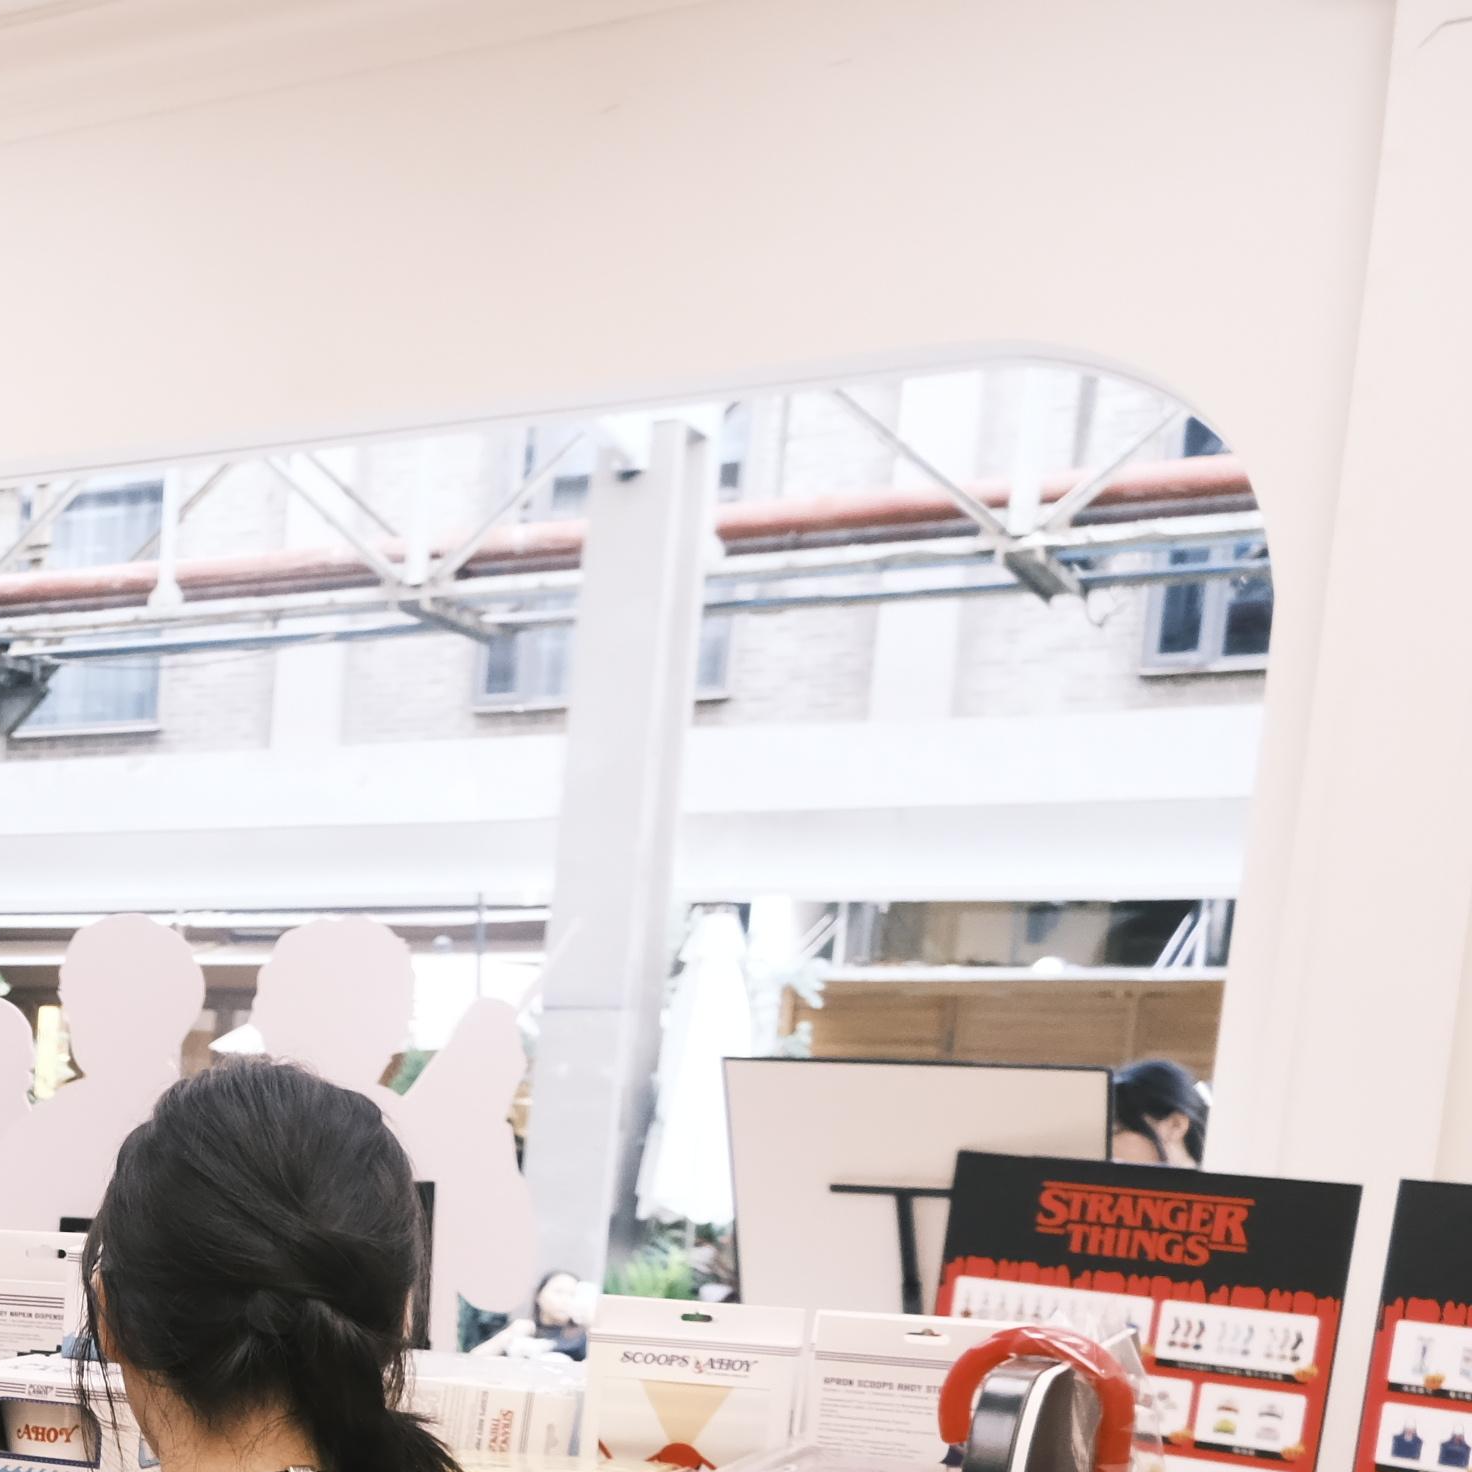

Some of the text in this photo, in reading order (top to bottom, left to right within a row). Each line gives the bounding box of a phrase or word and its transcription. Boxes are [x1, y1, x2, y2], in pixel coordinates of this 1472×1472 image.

[1036, 1186, 1249, 1246] STRANGER
[1066, 1223, 1210, 1267] THINGS
[620, 1351, 759, 1374] SCOOPS AHOY
[857, 1380, 894, 1391] SCOOPS
[897, 1383, 922, 1393] AHOY
[17, 1423, 80, 1444] AHOY
